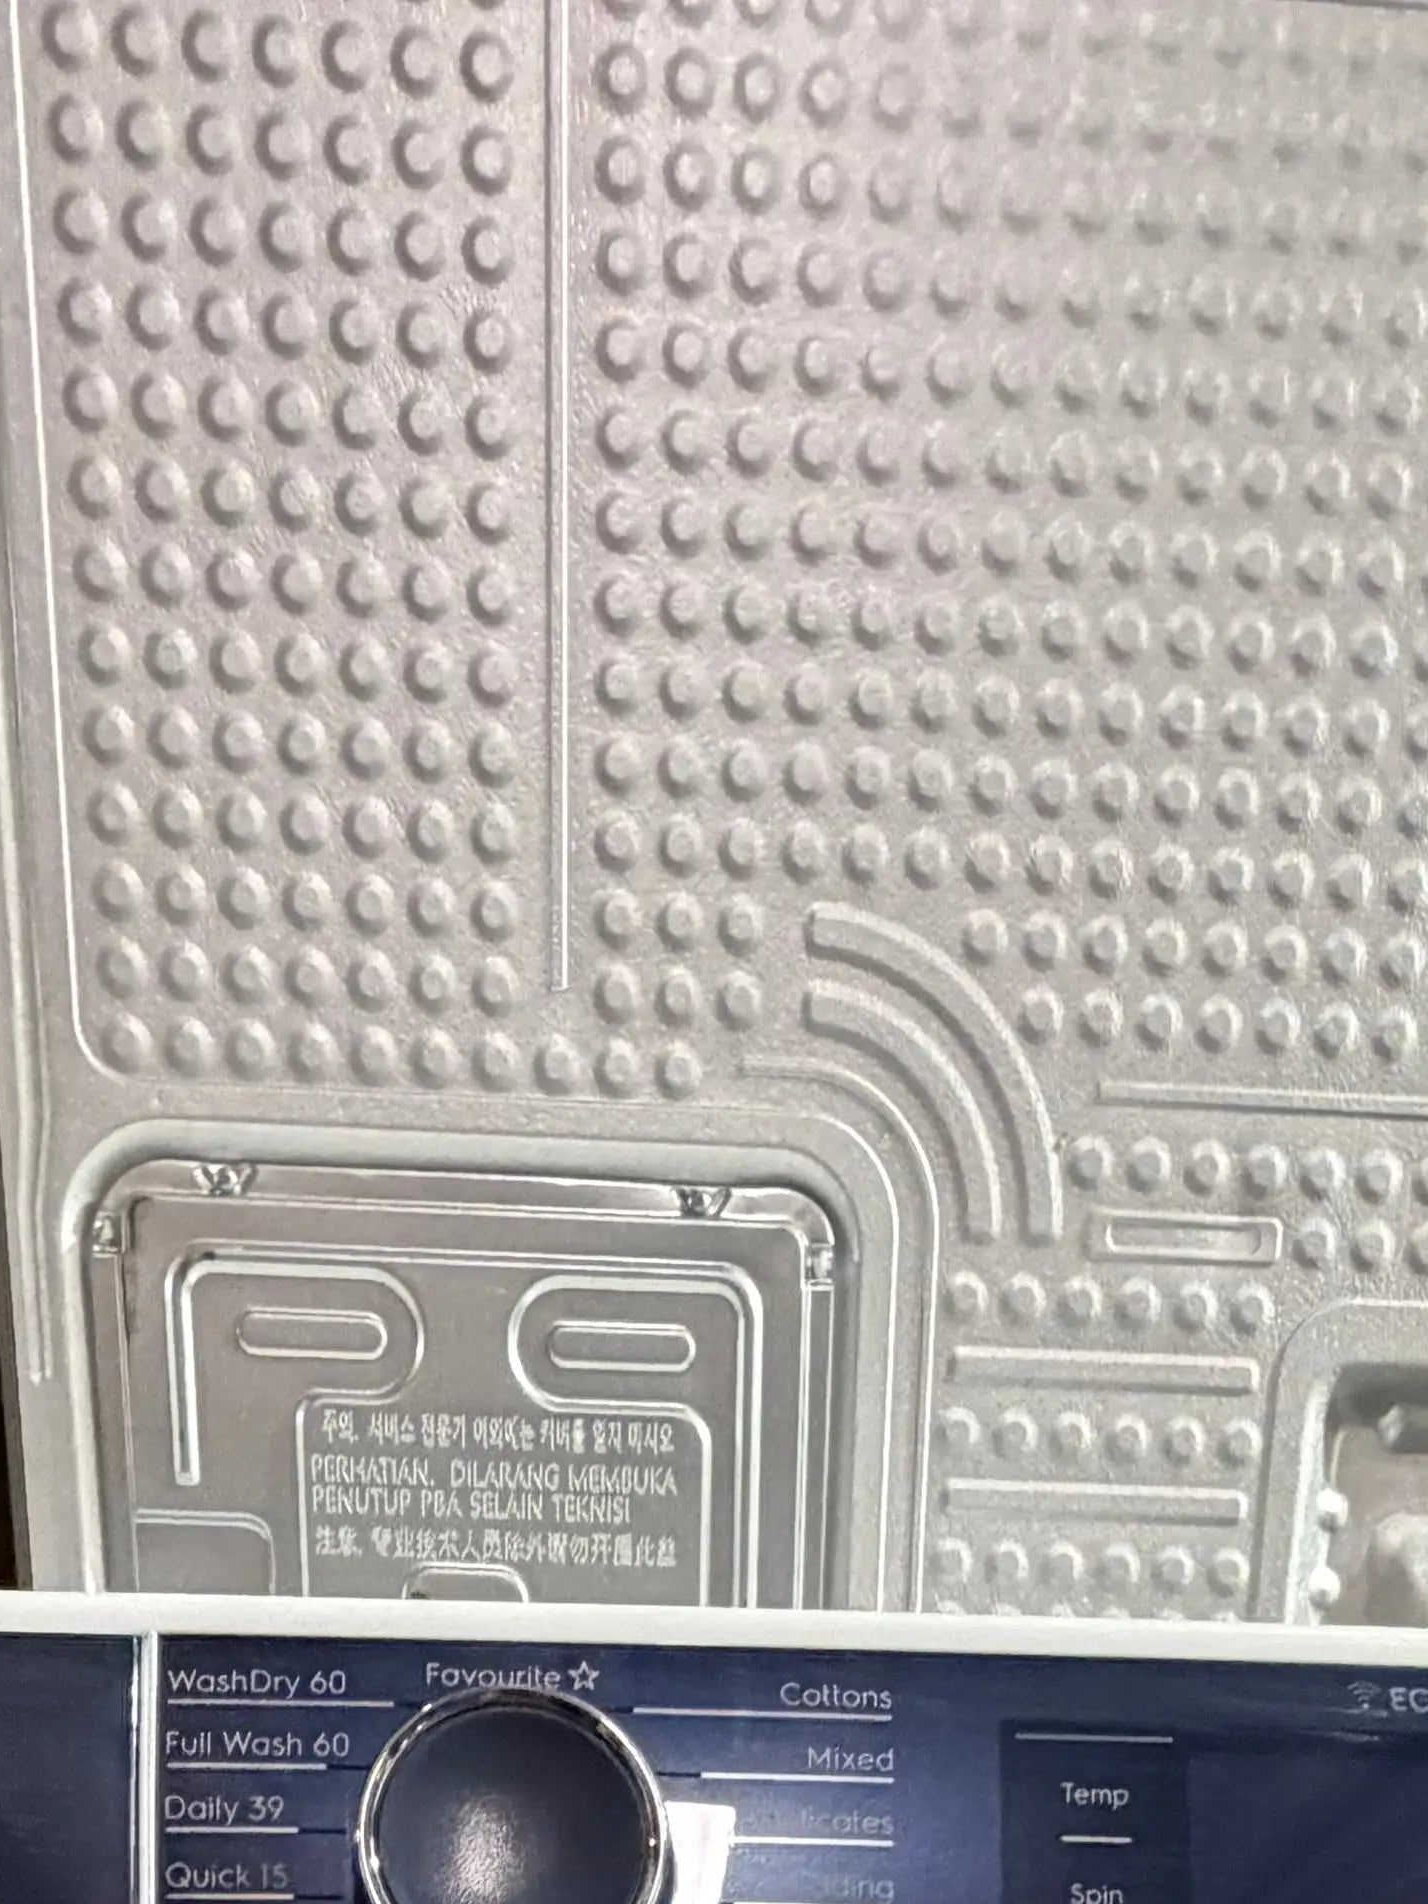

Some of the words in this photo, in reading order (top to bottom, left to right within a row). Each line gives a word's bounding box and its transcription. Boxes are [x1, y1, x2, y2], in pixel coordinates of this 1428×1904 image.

[450, 1458, 560, 1492] DILARANG
[568, 1462, 678, 1496] MEMBUKA
[312, 1483, 412, 1517] PENUTUP
[470, 1489, 543, 1521] SELAIN
[552, 1492, 631, 1525] TEKNISI
[167, 1670, 302, 1698] WashDry
[309, 1670, 347, 1695] 60
[425, 1662, 561, 1690] Favourite
[779, 1683, 893, 1709] Cottons
[164, 1732, 214, 1757] Full
[222, 1731, 303, 1758] Wash
[312, 1732, 351, 1757] 60
[806, 1746, 895, 1773] Mixed
[1061, 1782, 1130, 1809] Temp
[163, 1796, 240, 1826] Daily
[248, 1796, 285, 1821] 39
[165, 1862, 250, 1890] Quick
[259, 1862, 288, 1888] 15
